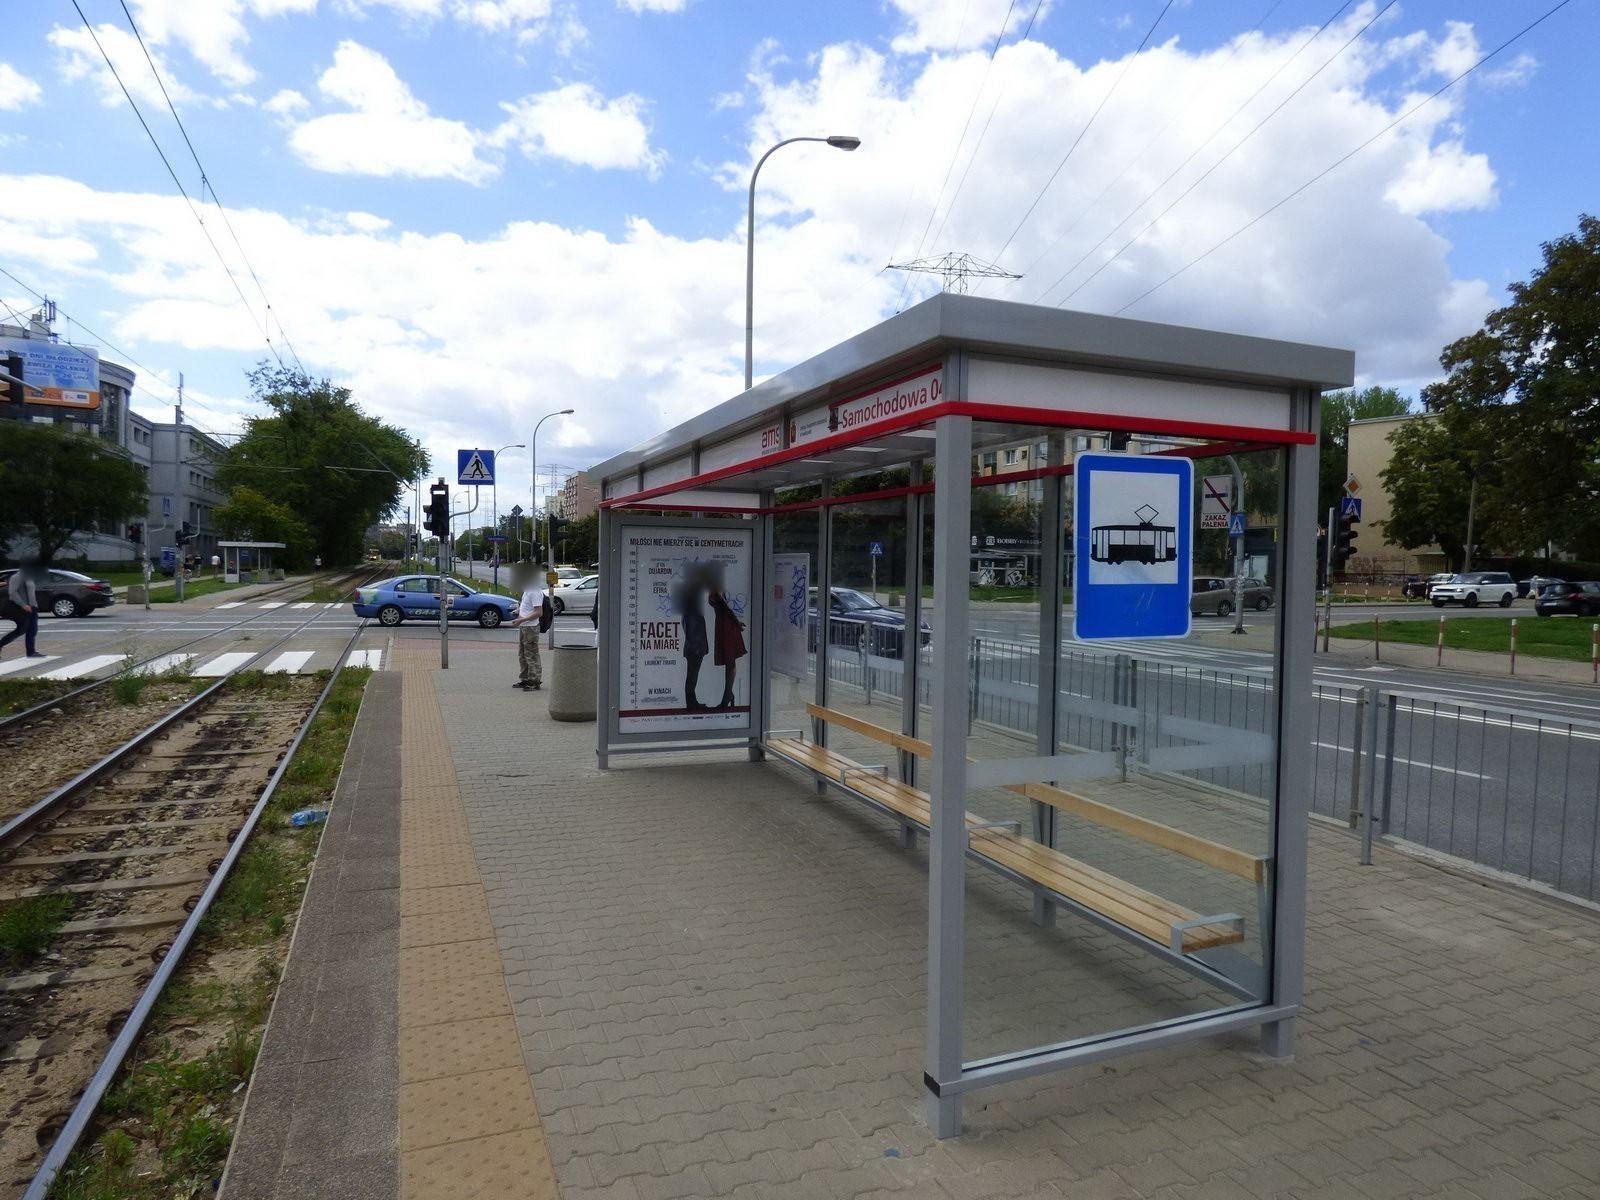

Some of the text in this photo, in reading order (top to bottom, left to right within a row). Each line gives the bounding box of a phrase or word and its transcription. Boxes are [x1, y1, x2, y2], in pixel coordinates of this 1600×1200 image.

[842, 389, 928, 429] Samochodowa
[640, 622, 680, 638] FACET
[640, 639, 652, 650] NA
[653, 639, 680, 651] MIARĘ
